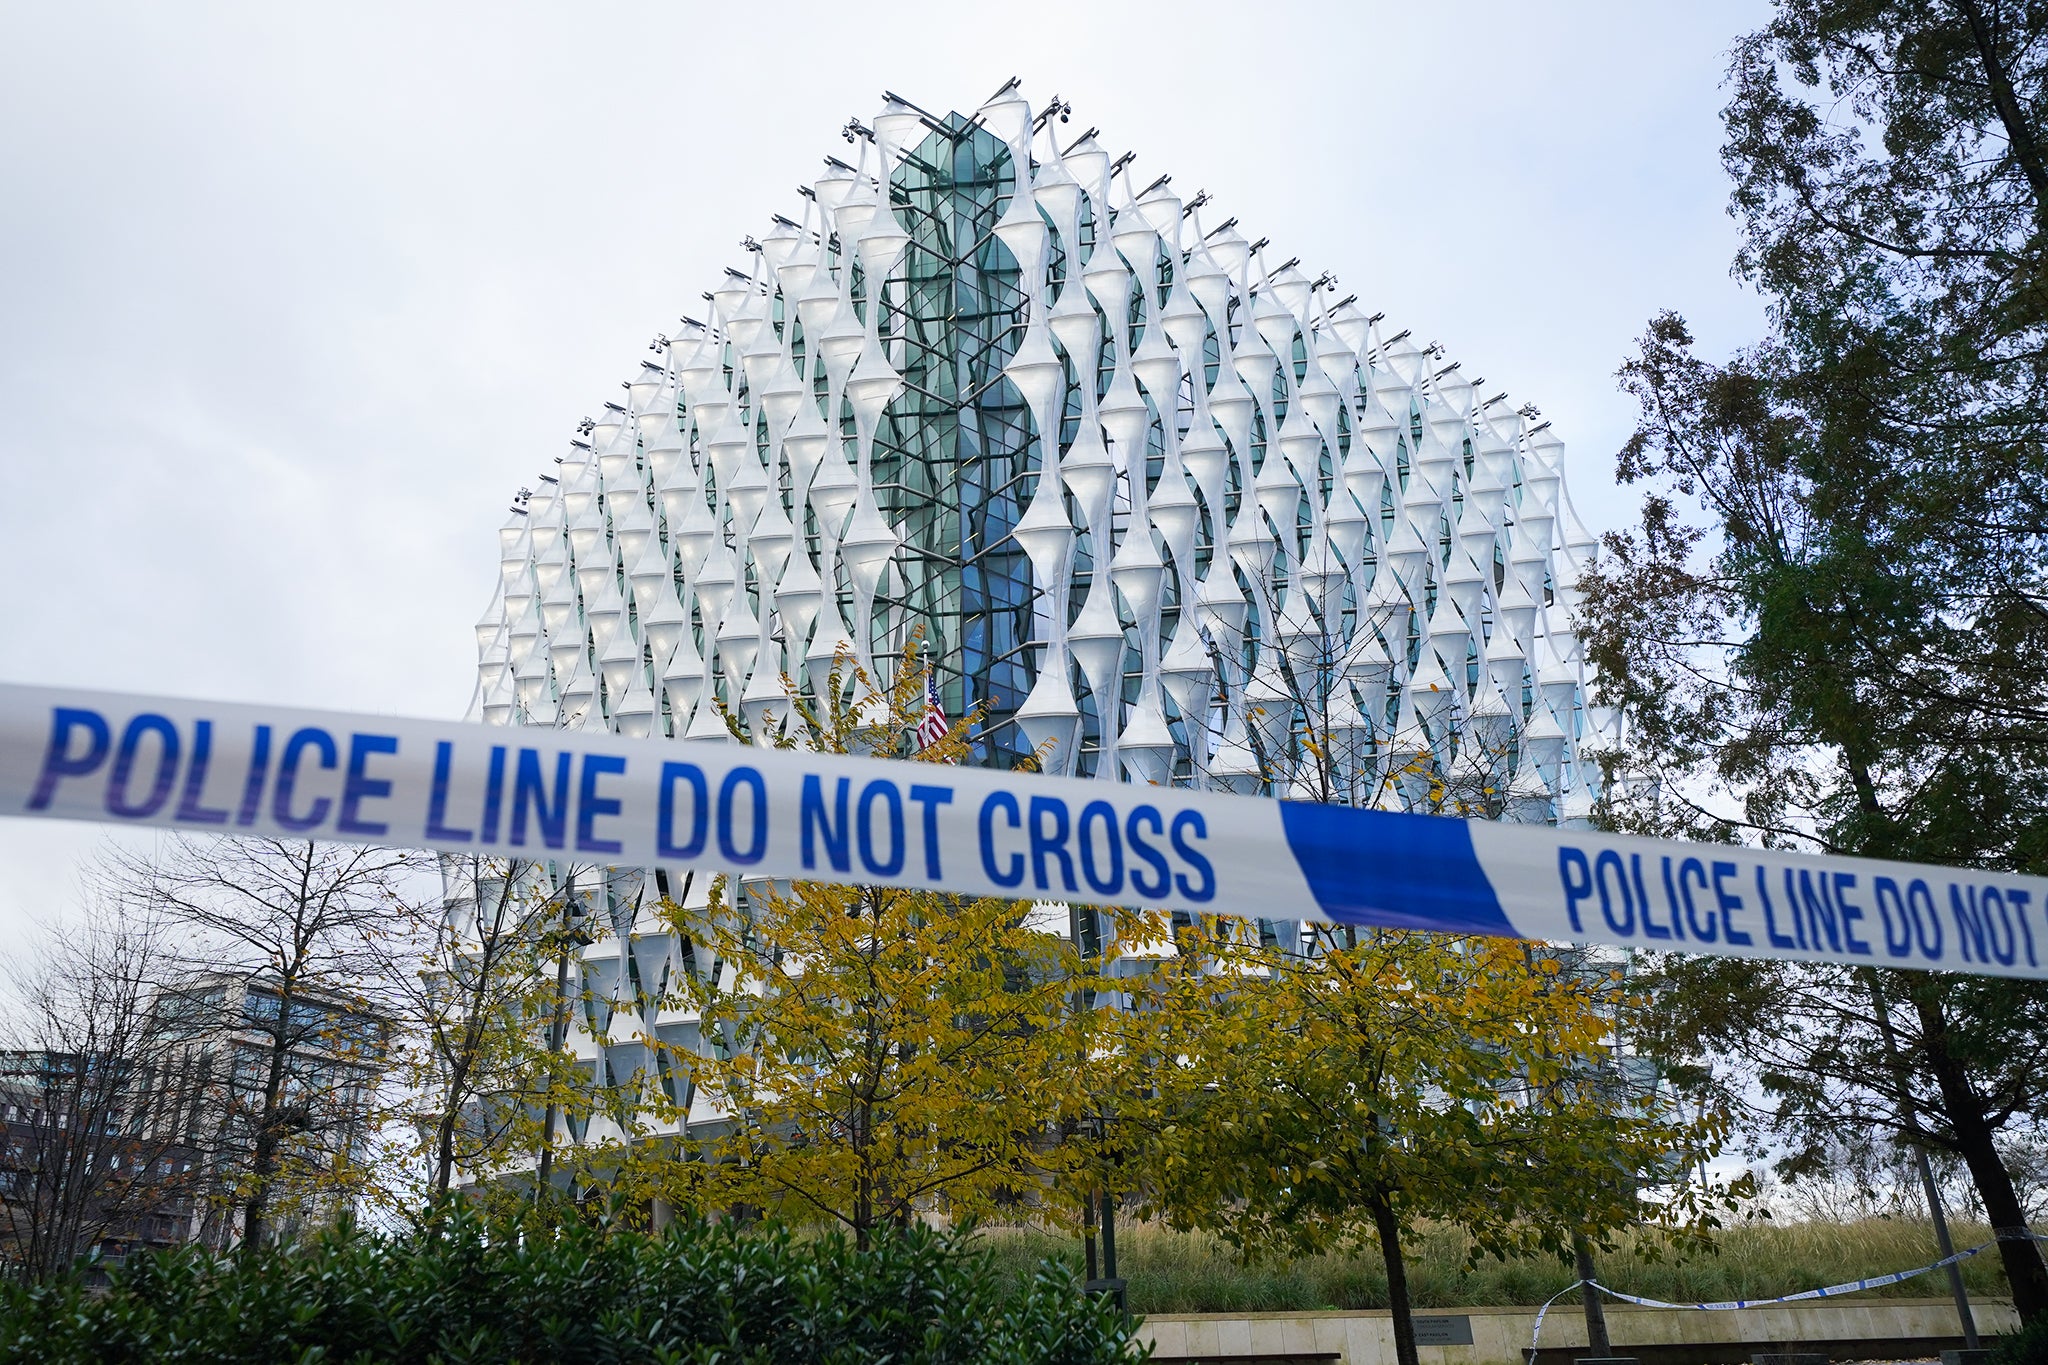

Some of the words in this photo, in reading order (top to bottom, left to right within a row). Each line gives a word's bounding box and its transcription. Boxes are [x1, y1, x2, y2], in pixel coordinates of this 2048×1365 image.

[26, 706, 400, 838] POLICE
[424, 741, 628, 856] LINE
[655, 761, 770, 868] DO
[799, 774, 955, 884] NOT
[977, 789, 1218, 906] CROSS
[1557, 846, 1754, 946] POLICE
[1755, 864, 1873, 956] LINE
[1874, 876, 1943, 962] DO
[1948, 883, 2040, 968] NOT
